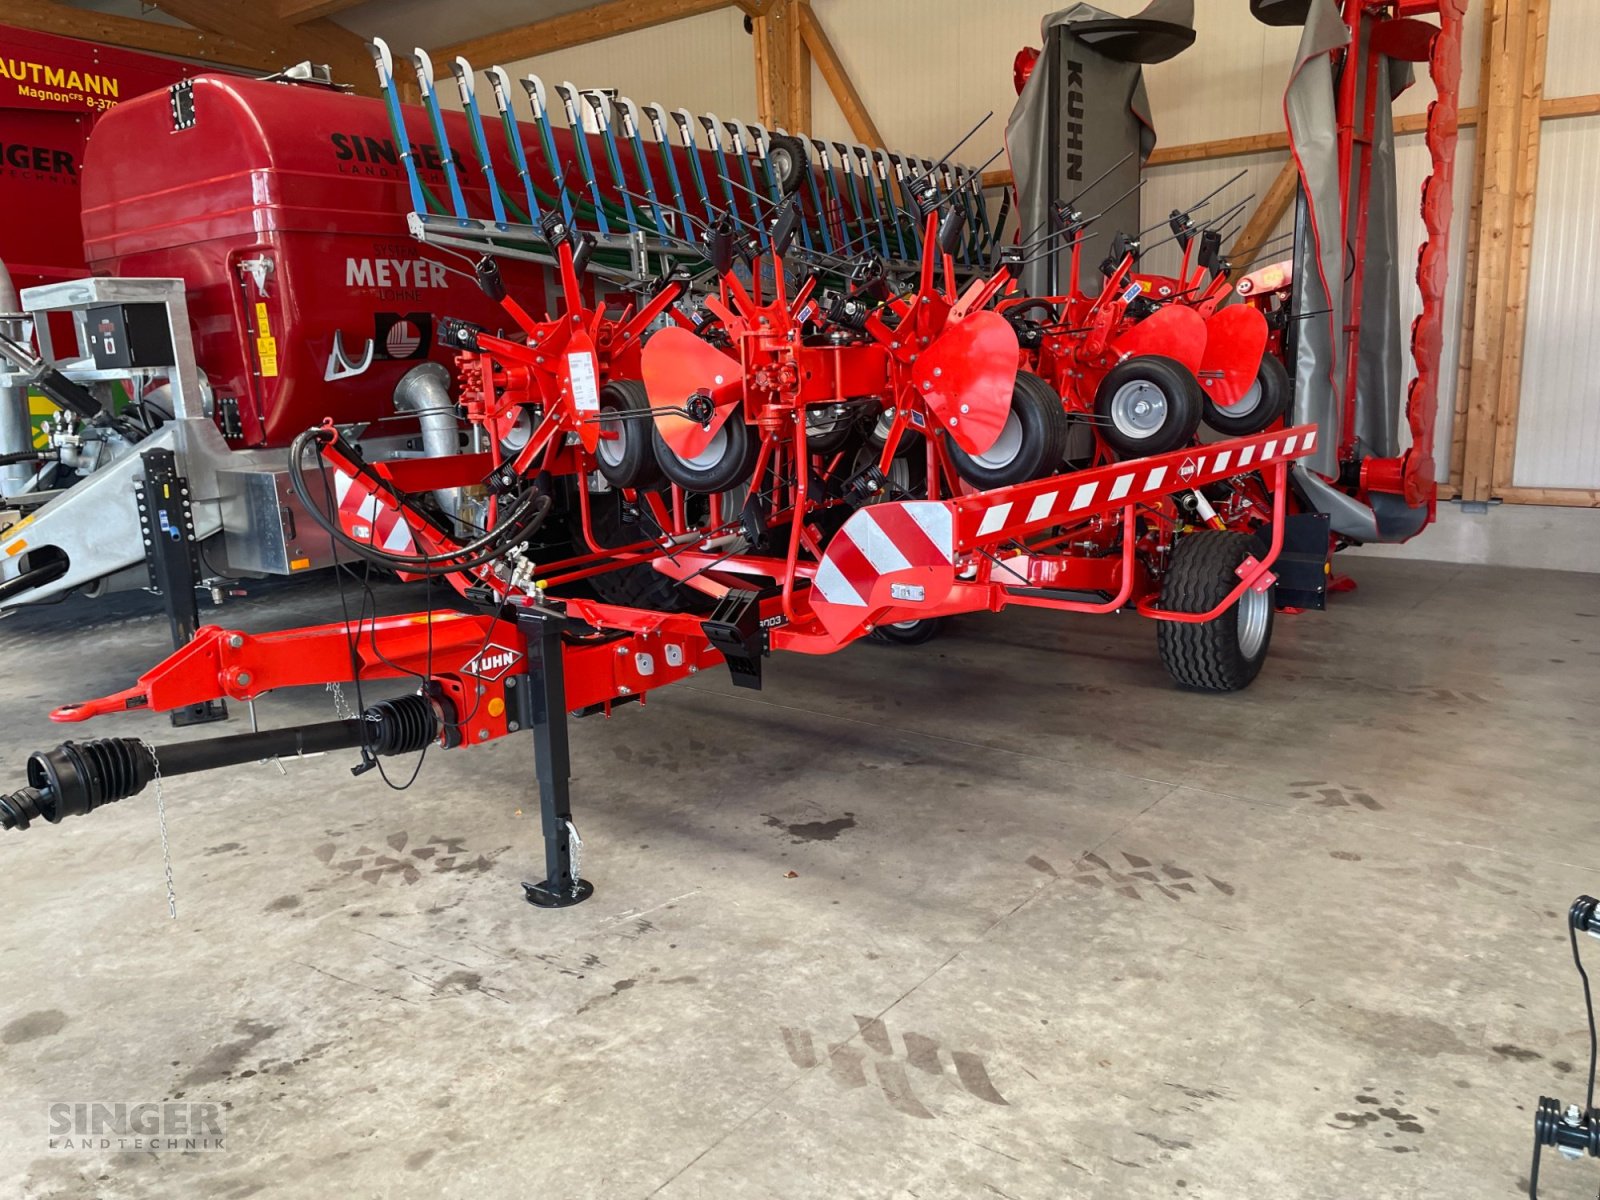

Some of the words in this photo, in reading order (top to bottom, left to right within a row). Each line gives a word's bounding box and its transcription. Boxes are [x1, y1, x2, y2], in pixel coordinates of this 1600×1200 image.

[1067, 60, 1083, 181] KUHN
[0, 142, 77, 175] GER
[346, 258, 449, 289] MEYER
[471, 652, 513, 674] KUHN
